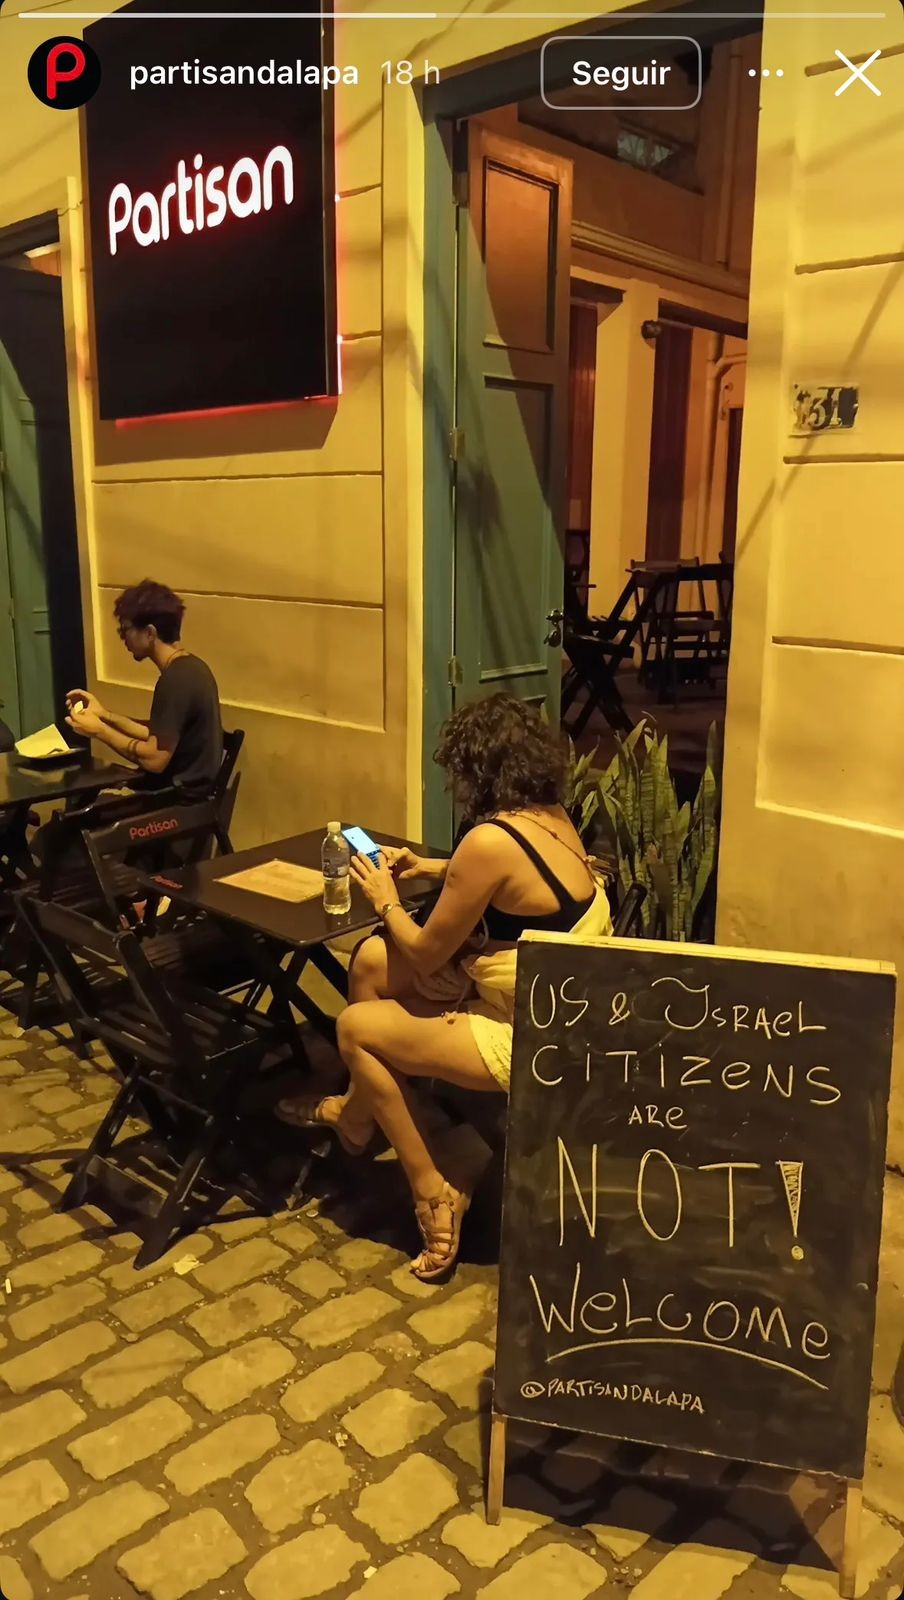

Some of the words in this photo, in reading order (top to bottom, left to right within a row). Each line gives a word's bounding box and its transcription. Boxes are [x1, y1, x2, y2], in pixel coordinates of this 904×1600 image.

[108, 145, 294, 256] Partisan
[129, 818, 178, 840] Partisan
[529, 973, 589, 1029] US
[608, 992, 631, 1026] &
